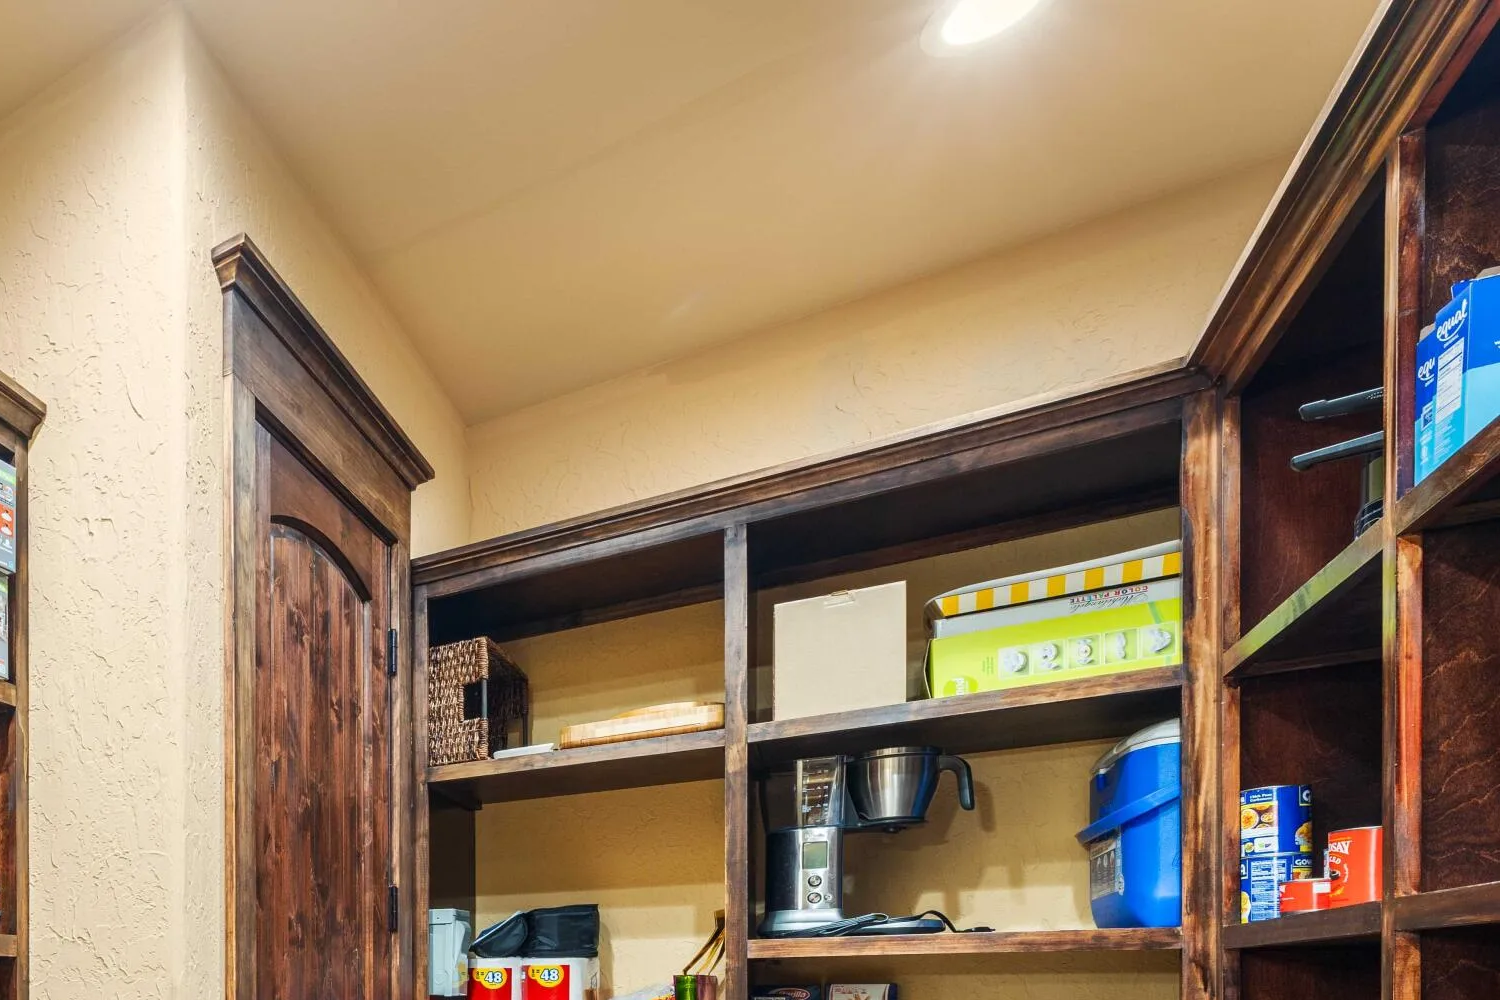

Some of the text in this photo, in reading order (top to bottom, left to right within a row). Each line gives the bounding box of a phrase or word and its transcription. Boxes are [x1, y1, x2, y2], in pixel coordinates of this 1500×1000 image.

[1436, 299, 1468, 341] equal
[485, 971, 503, 985] 48
[540, 969, 559, 983] 48
